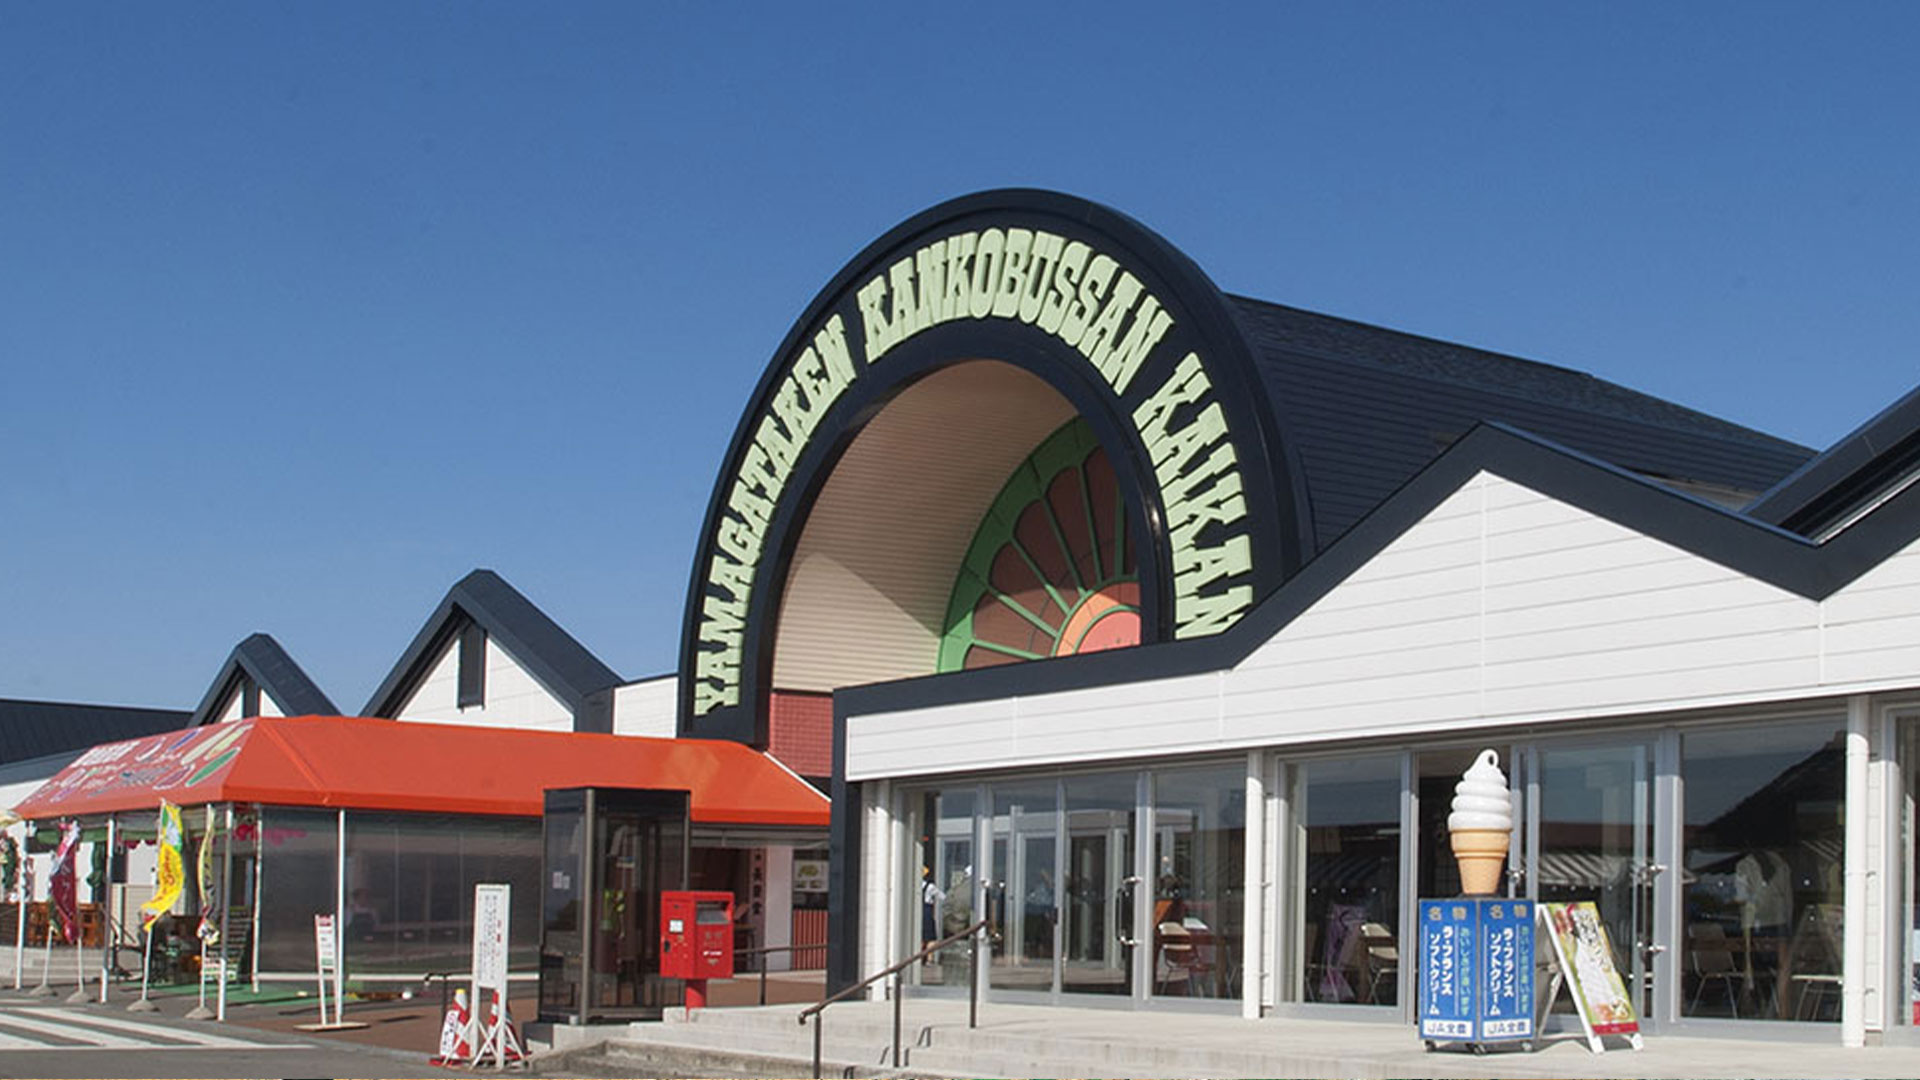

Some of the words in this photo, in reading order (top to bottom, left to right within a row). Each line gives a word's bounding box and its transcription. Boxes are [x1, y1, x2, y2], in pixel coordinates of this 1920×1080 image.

[694, 314, 859, 716] YAMAGATAKEN
[856, 228, 1174, 397] KANKOBUSSAN
[1132, 351, 1254, 640] KAIKAN
[1429, 933, 1441, 1015] ソフトクリーム
[1490, 933, 1502, 1015] ソフトクリーム
